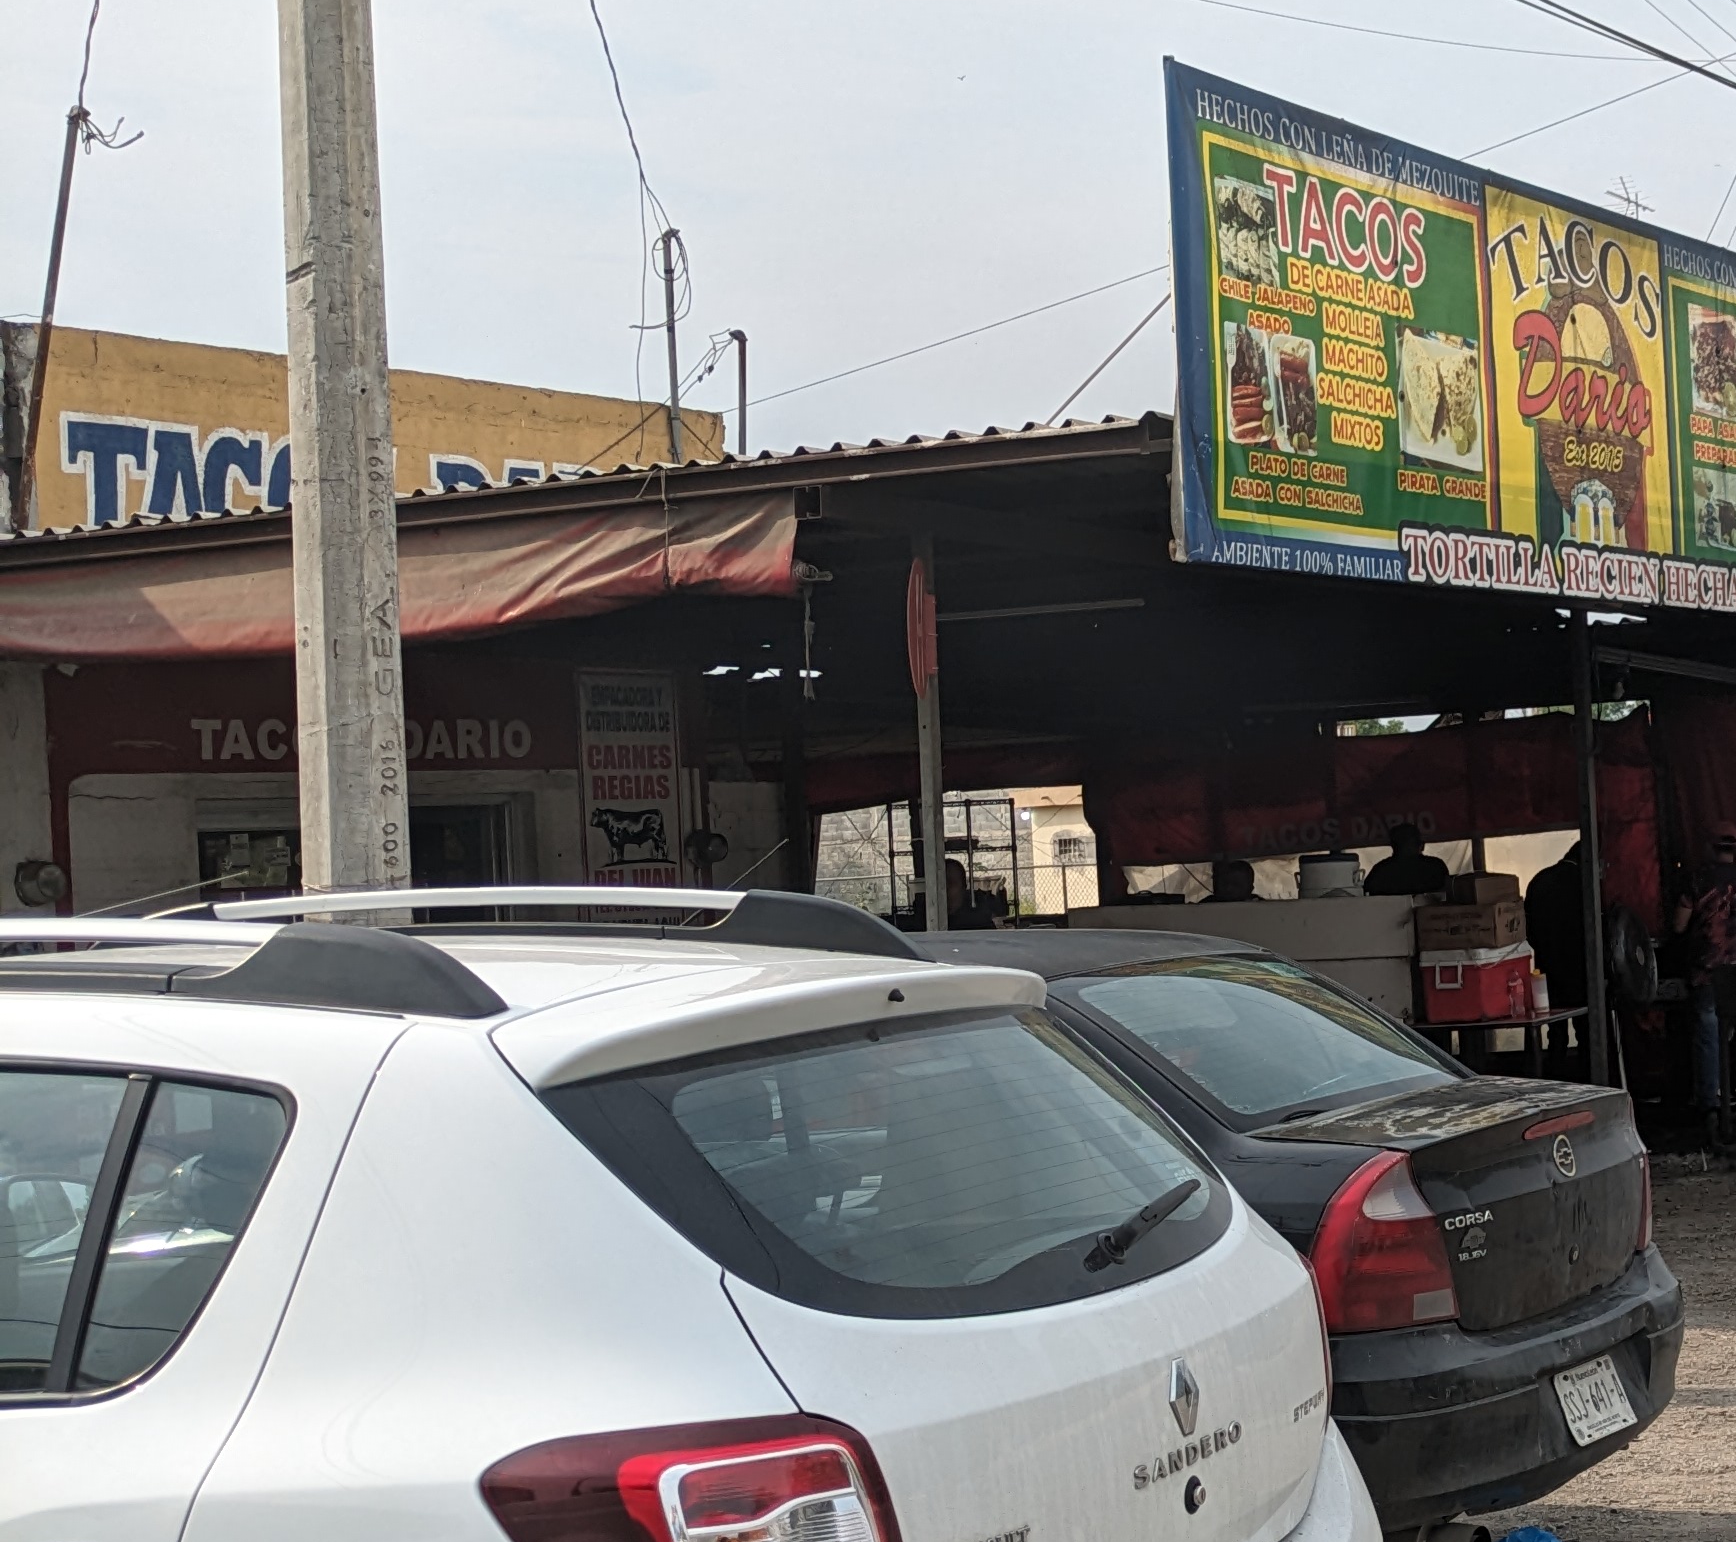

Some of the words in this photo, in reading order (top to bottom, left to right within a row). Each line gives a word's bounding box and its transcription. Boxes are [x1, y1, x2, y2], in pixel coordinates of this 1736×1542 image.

[1196, 89, 1274, 140] HECHOS
[1280, 118, 1316, 153] CON
[1322, 133, 1367, 172] LEÑA
[1372, 148, 1395, 178] DE
[1398, 156, 1480, 206] MEZQUITE
[1263, 163, 1426, 288] TACOS
[1487, 215, 1661, 341] TACOS
[1664, 244, 1712, 280] HECHOS
[1714, 261, 1736, 288] CON
[1219, 276, 1252, 302] CHILE
[1287, 258, 1311, 289] DE
[1314, 268, 1365, 305] CARNE
[1367, 279, 1415, 319] ASADA
[1248, 310, 1291, 336] ASADO
[1323, 303, 1385, 347] MOLLEJA
[1323, 338, 1387, 382] MACHITO
[1513, 309, 1650, 439] Dario
[1317, 373, 1396, 418] SALCHICHA
[1331, 411, 1383, 451] MIXTOS
[1690, 414, 1714, 438] PAPA
[1250, 454, 1288, 477] PLATO
[1291, 460, 1308, 478] DE
[1310, 463, 1347, 486] CARNE
[1398, 470, 1440, 495] PIRATA
[1444, 478, 1487, 501] GRANDE
[1231, 477, 1272, 502] ASADA
[1277, 485, 1302, 505] CON
[1306, 489, 1363, 515] SALCHICHA
[1212, 541, 1290, 570] AMBIENTE
[1294, 549, 1333, 575] 100%
[1337, 555, 1403, 581] FAMILIAR
[1402, 526, 1559, 593] TORTILLA
[1562, 546, 1659, 605] RECIEN
[406, 718, 532, 759] DARIO
[587, 744, 672, 770] CARNES
[592, 775, 670, 800] REGIAS
[1241, 818, 1340, 849] TACOS
[1444, 1210, 1494, 1231] CORSA
[1563, 1373, 1627, 1424] SSJ-641-A
[1133, 1420, 1242, 1490] SANDERO
